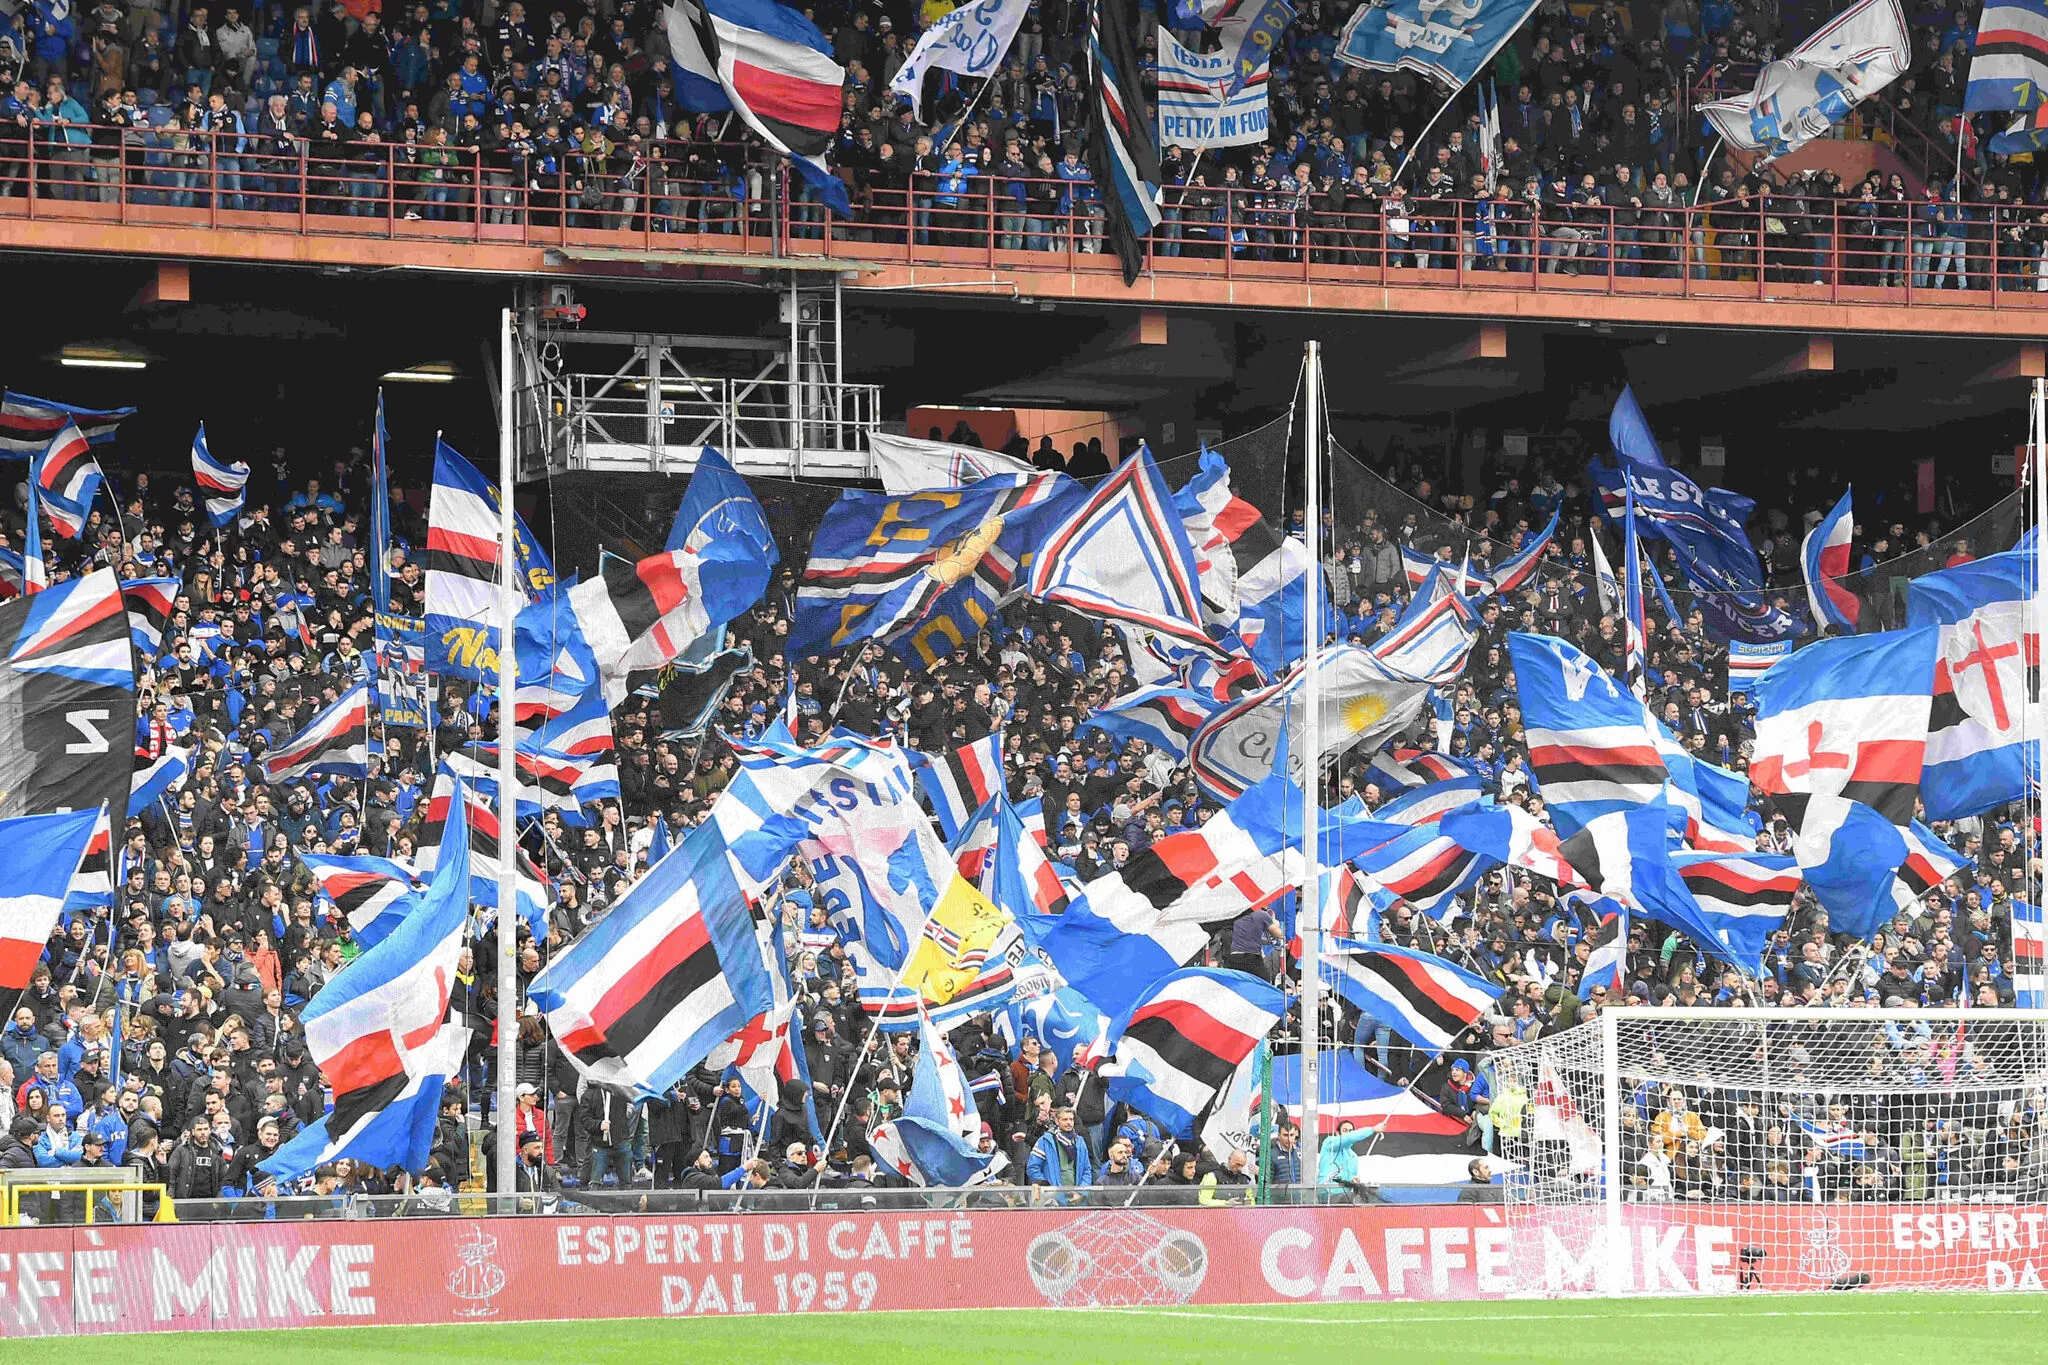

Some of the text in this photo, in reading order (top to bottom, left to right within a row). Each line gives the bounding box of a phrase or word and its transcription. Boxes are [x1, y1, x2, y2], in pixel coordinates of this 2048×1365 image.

[1164, 115, 1215, 139] PETTO
[1219, 115, 1237, 138] IN
[375, 612, 412, 632] COME
[557, 1211, 975, 1266] ESPERTI DI CAFFÈ
[1260, 1207, 1736, 1298] CAFFÈ MIKE
[153, 1244, 376, 1322] MIKE
[661, 1270, 879, 1315] DAL 1959
[1986, 1259, 2045, 1292] DA
